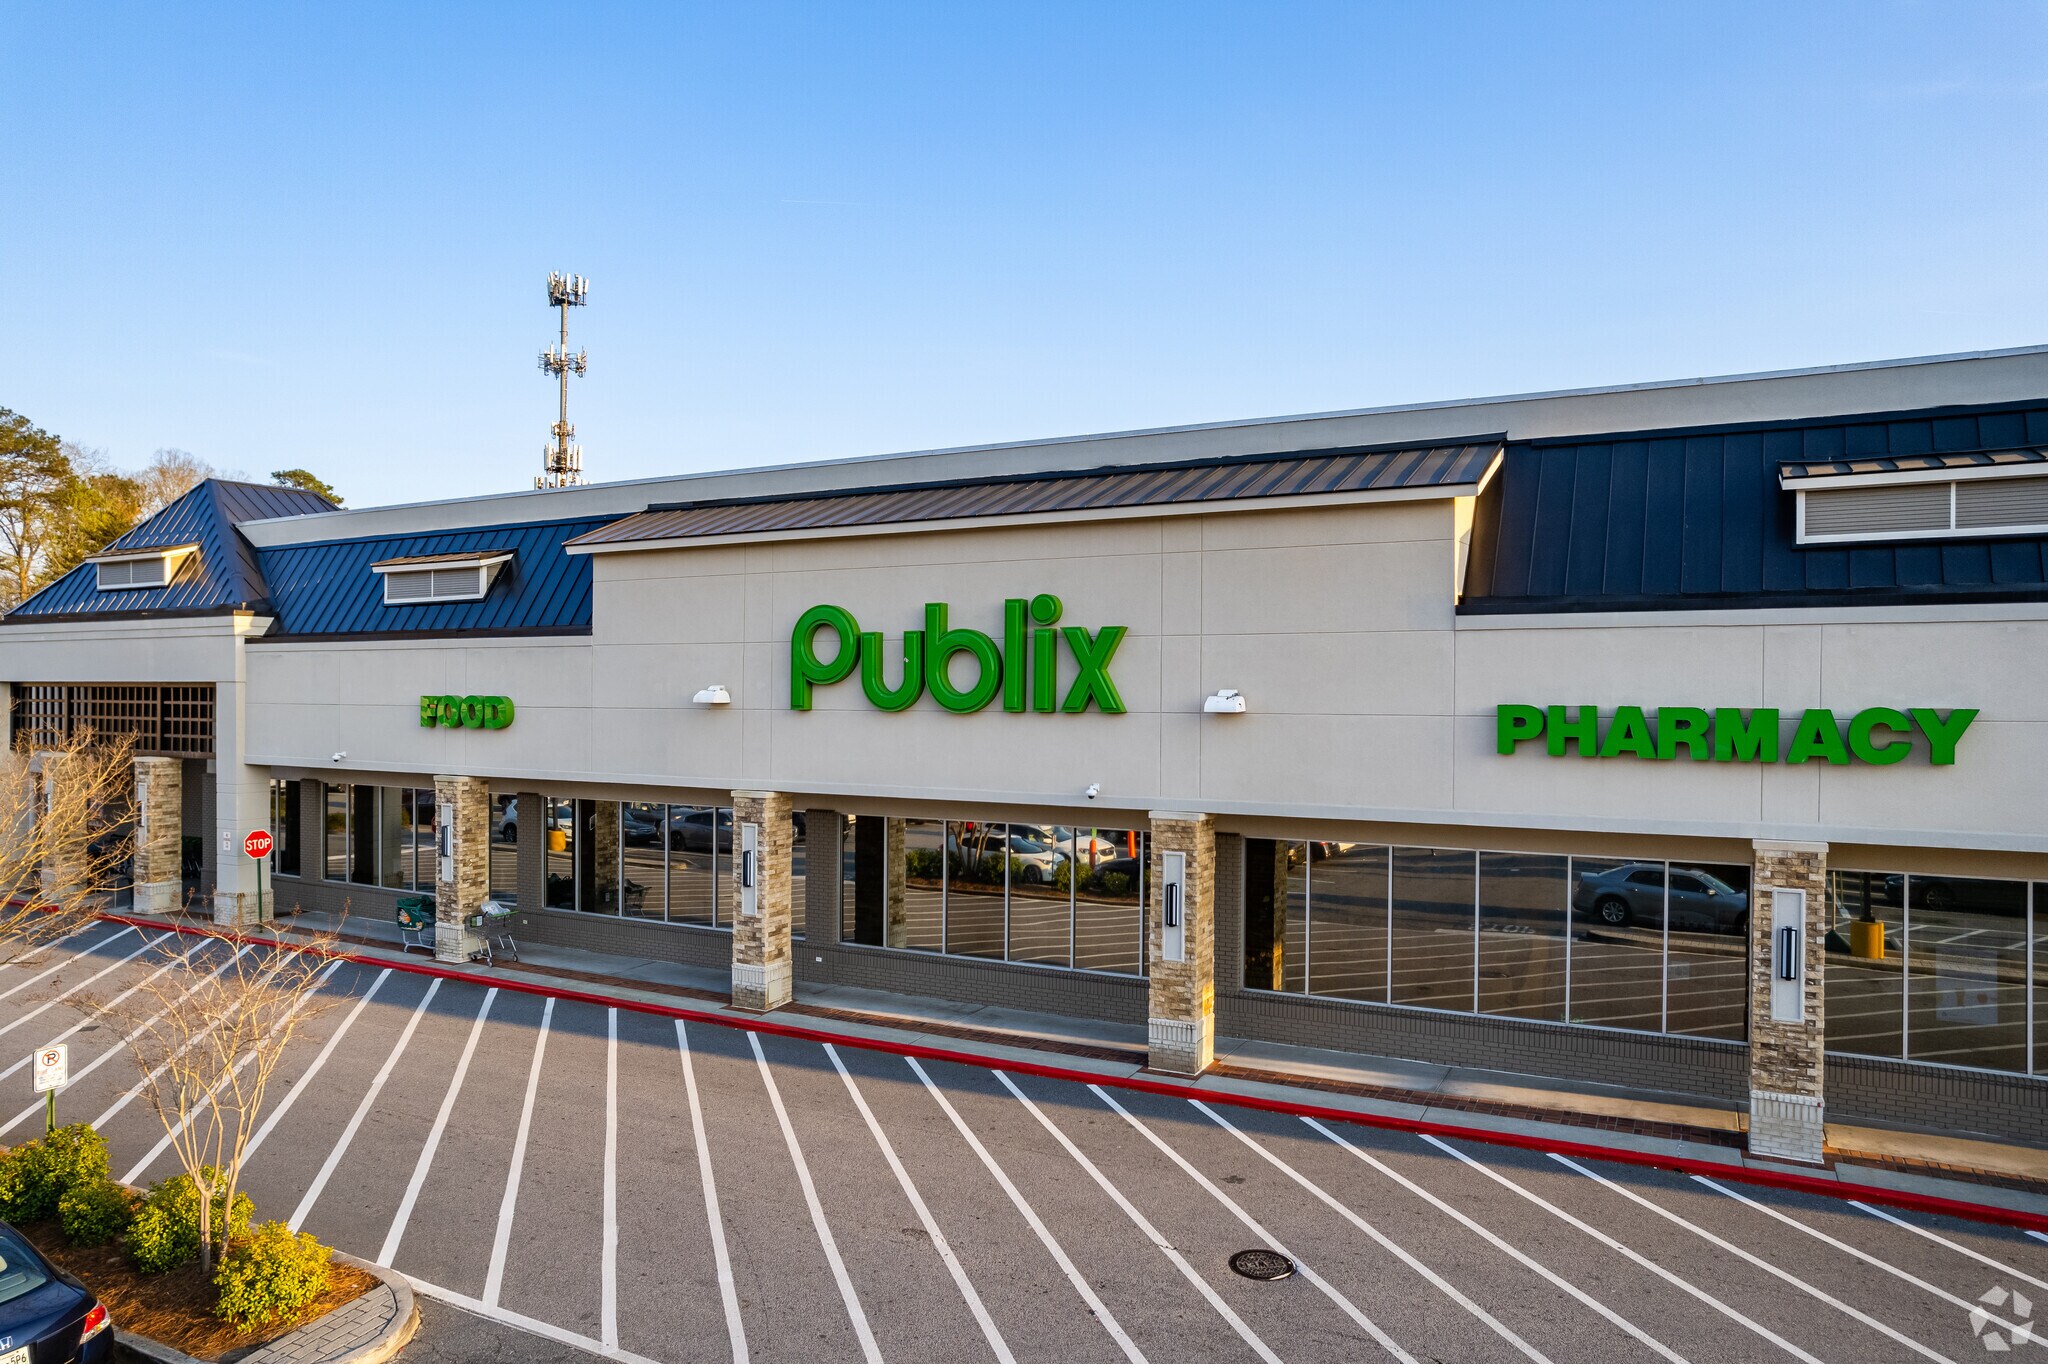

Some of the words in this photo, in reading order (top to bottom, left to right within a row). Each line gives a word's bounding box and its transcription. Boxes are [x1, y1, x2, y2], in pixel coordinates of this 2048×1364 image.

[790, 593, 1128, 713] Publix
[420, 695, 515, 728] FOOD
[1496, 704, 1981, 766] PHARMACY
[246, 837, 271, 851] STOP
